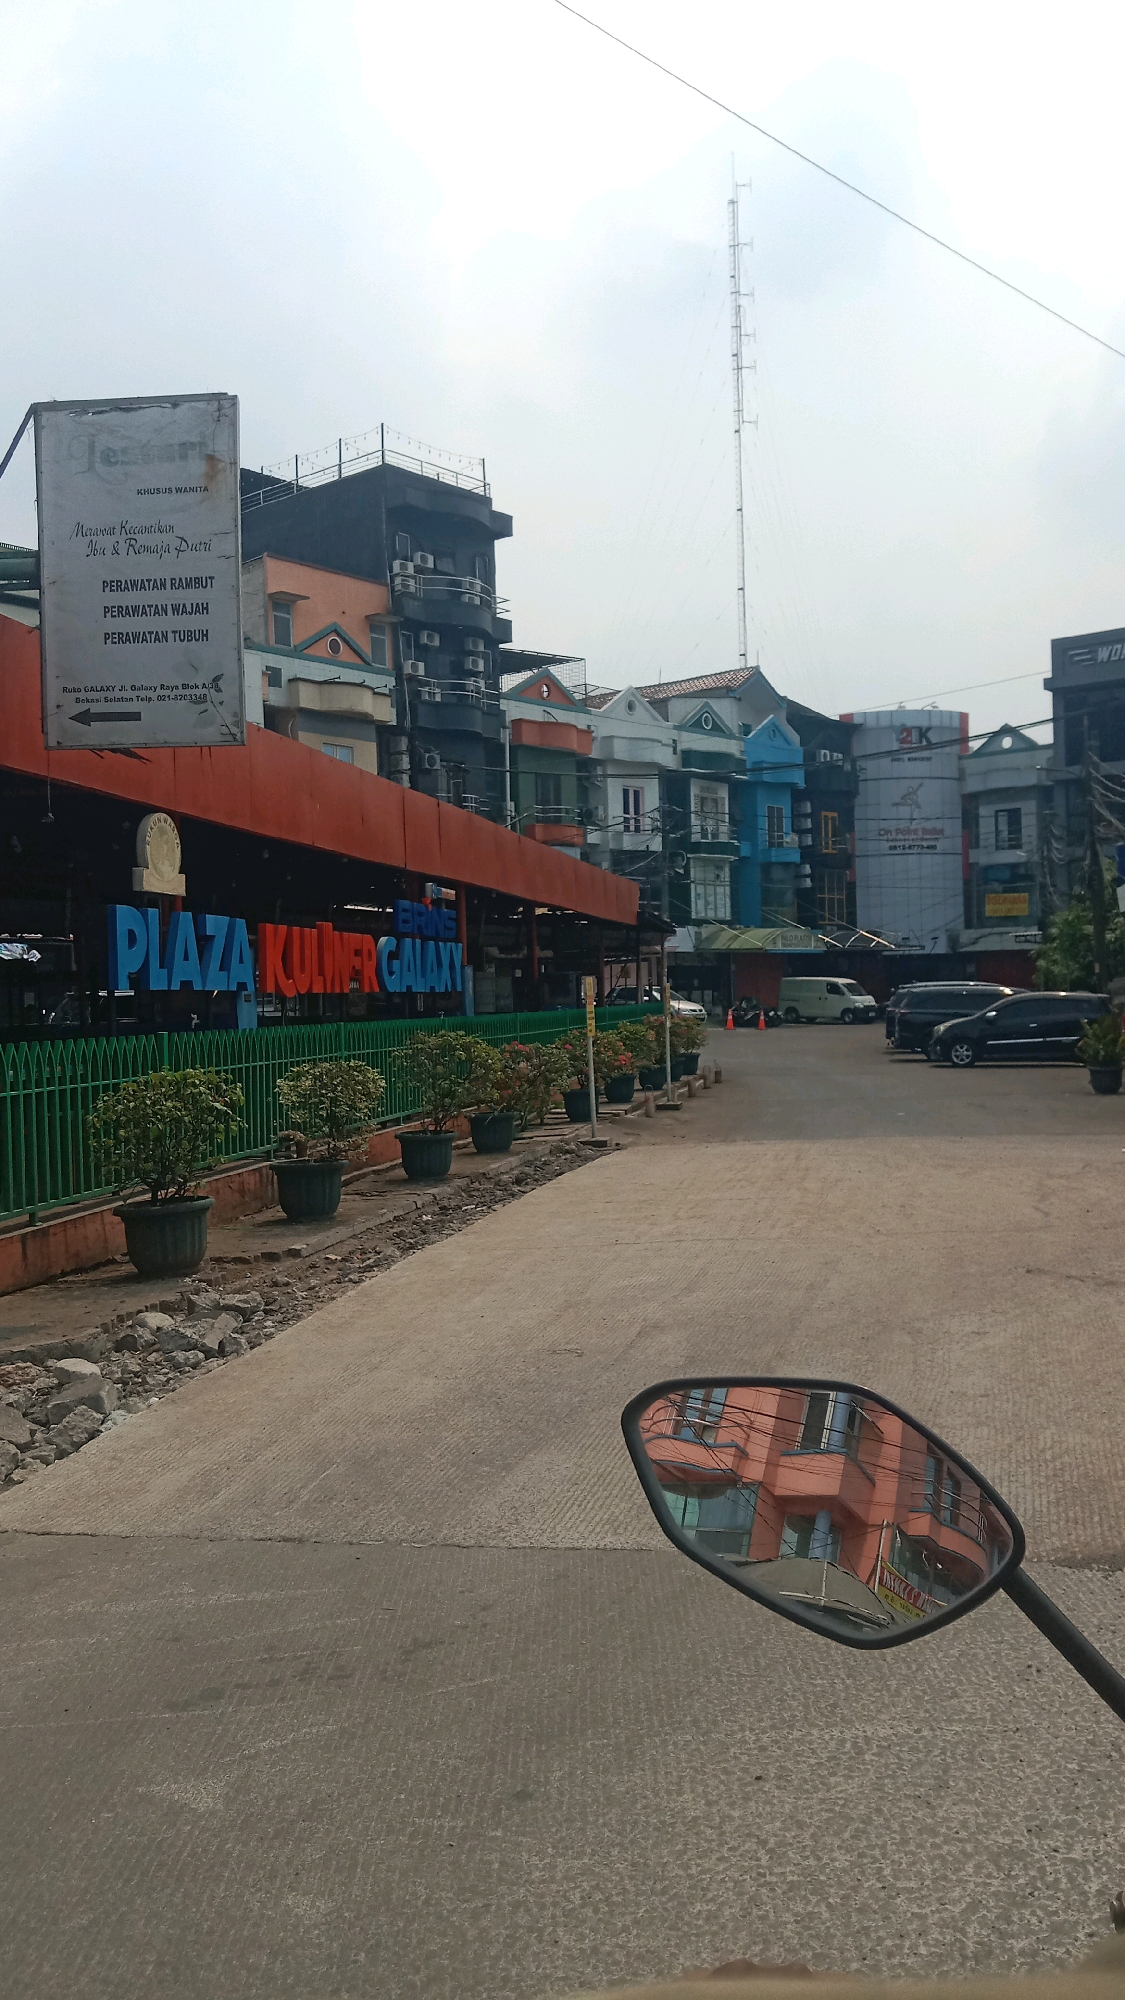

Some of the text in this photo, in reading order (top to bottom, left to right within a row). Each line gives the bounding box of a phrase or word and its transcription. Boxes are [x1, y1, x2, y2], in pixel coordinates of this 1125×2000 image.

[137, 486, 209, 495] KHUSUS WANITA
[70, 519, 175, 540] Merawat Kecantikan
[86, 535, 212, 560] Ibu & Remaja Putri
[102, 576, 215, 593] PERAWATAN RAMBUT
[103, 602, 209, 618] PERAWATAN WAJAH
[104, 629, 209, 645] PERAWATAN TUBUH
[1097, 643, 1125, 662] WO
[130, 684, 158, 693] Galaxy
[160, 683, 179, 692] Raya
[136, 695, 155, 704] Telp.
[146, 816, 162, 846] RUKUN
[108, 904, 463, 997] PLAZA KULINER GALAXY
